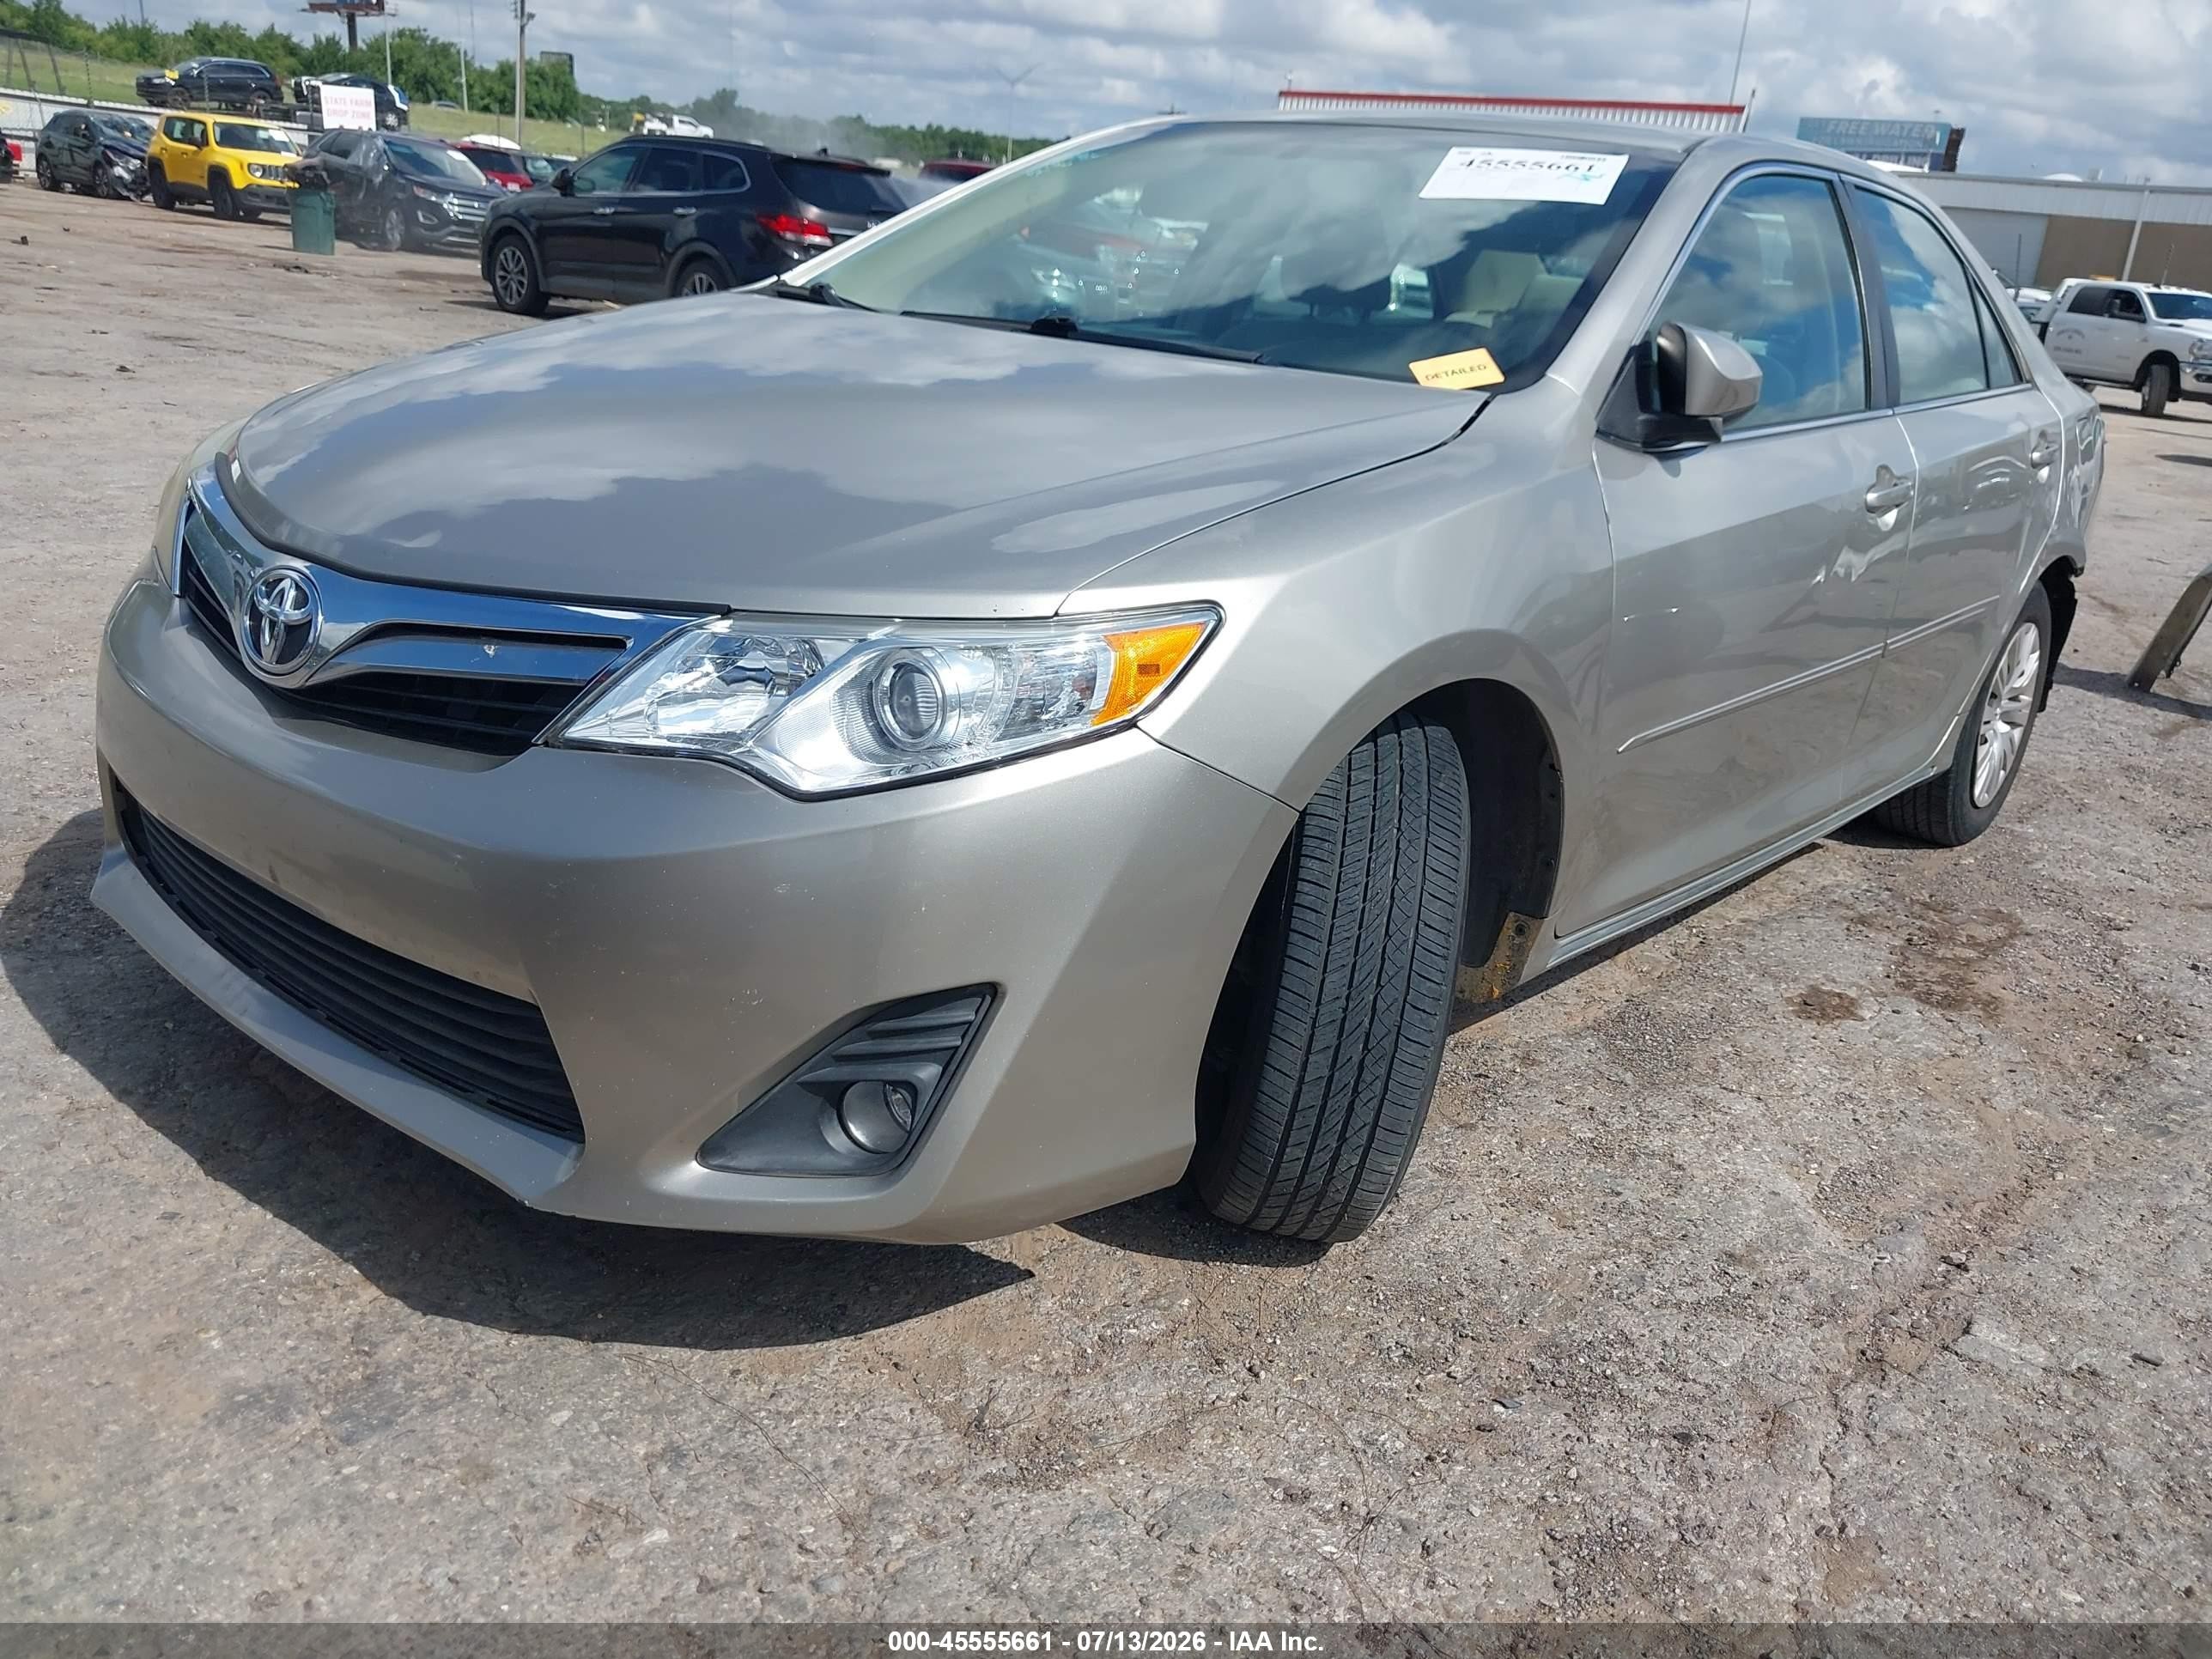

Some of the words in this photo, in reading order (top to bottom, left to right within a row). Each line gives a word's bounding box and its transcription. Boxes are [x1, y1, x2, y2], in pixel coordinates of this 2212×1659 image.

[1826, 119, 1869, 135] FREE
[1874, 121, 1936, 139] WATER
[1425, 363, 1487, 381] DETAILED
